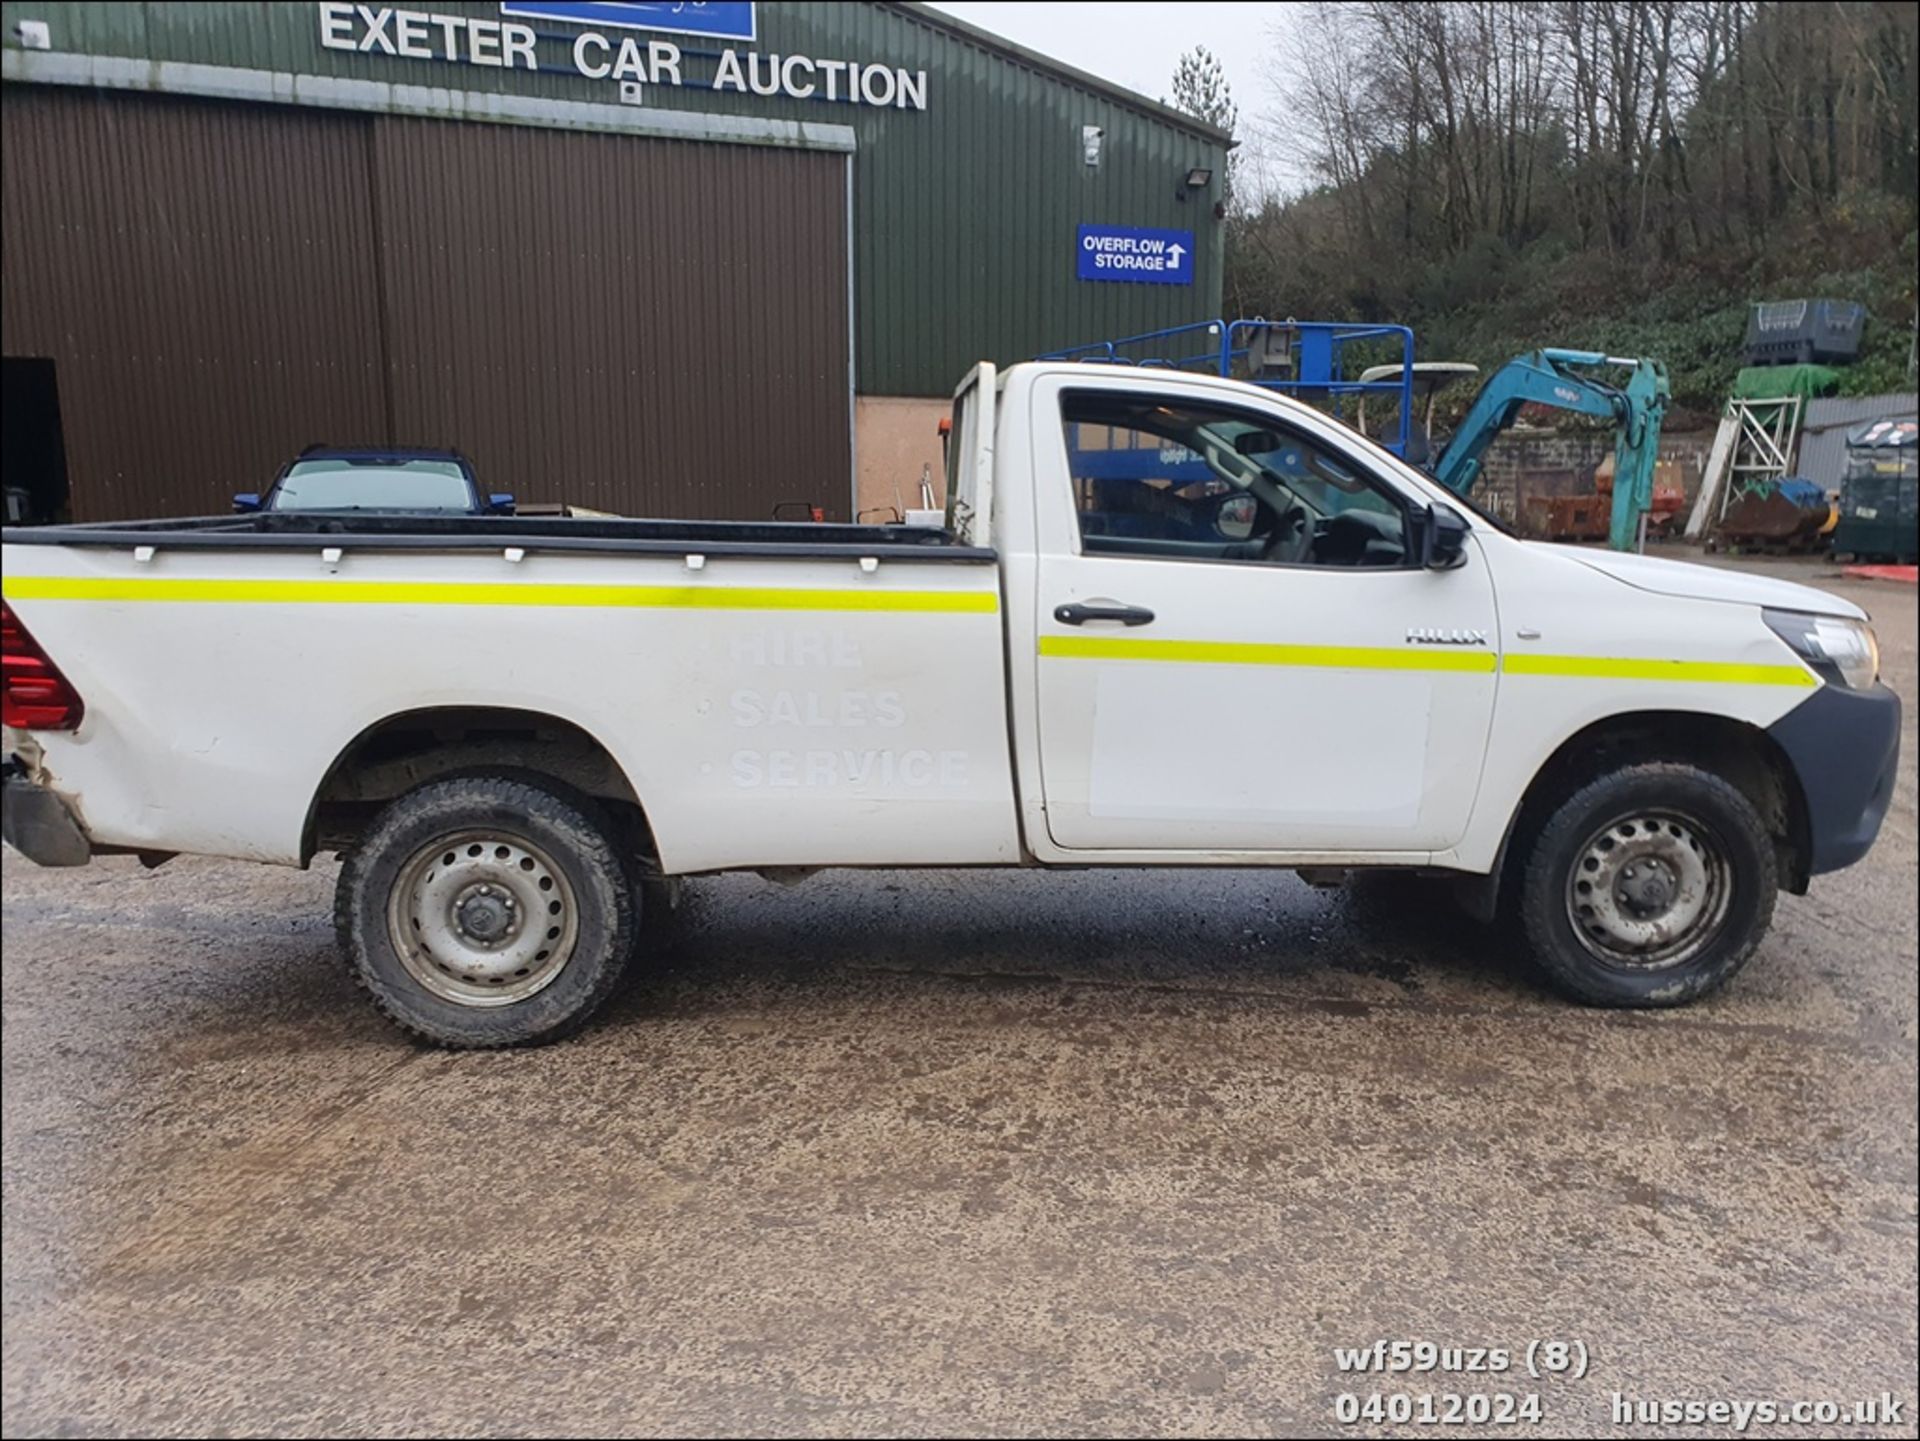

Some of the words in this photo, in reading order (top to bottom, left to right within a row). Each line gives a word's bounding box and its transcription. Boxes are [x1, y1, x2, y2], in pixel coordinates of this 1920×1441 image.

[319, 2, 537, 70] EXETER
[574, 32, 681, 85] CAR
[713, 49, 926, 110] AUCTION
[1083, 235, 1165, 254] OVERFLOW
[1095, 253, 1164, 270] STORAGE
[728, 628, 862, 668] HIRE
[1406, 628, 1486, 645] HILUX
[729, 689, 906, 728] SALES
[731, 749, 970, 788] SERVICE
